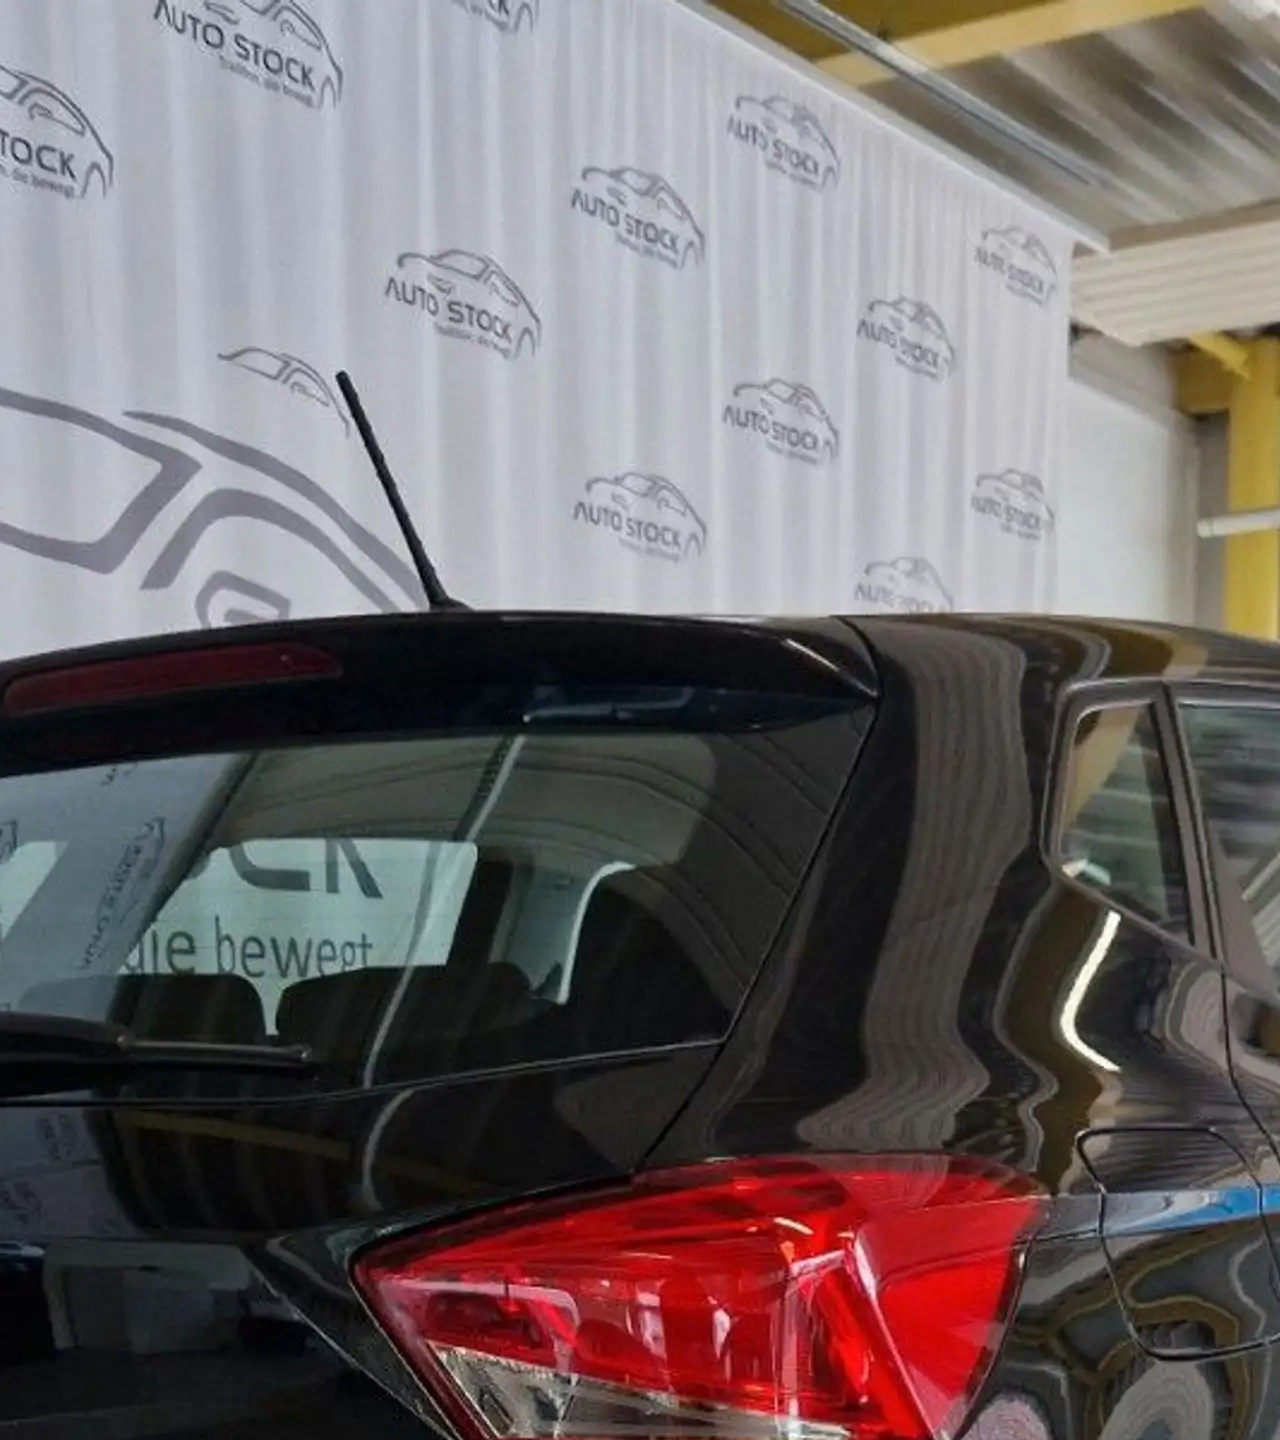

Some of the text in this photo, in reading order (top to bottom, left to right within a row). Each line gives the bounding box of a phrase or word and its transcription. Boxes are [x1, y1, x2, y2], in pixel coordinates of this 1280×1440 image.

[153, 0, 225, 48] AUTO
[234, 34, 315, 92] STOCK
[571, 188, 619, 226] AUTO
[385, 277, 439, 316] AUTO
[448, 301, 511, 343] STOCK
[573, 501, 622, 531] AUTO
